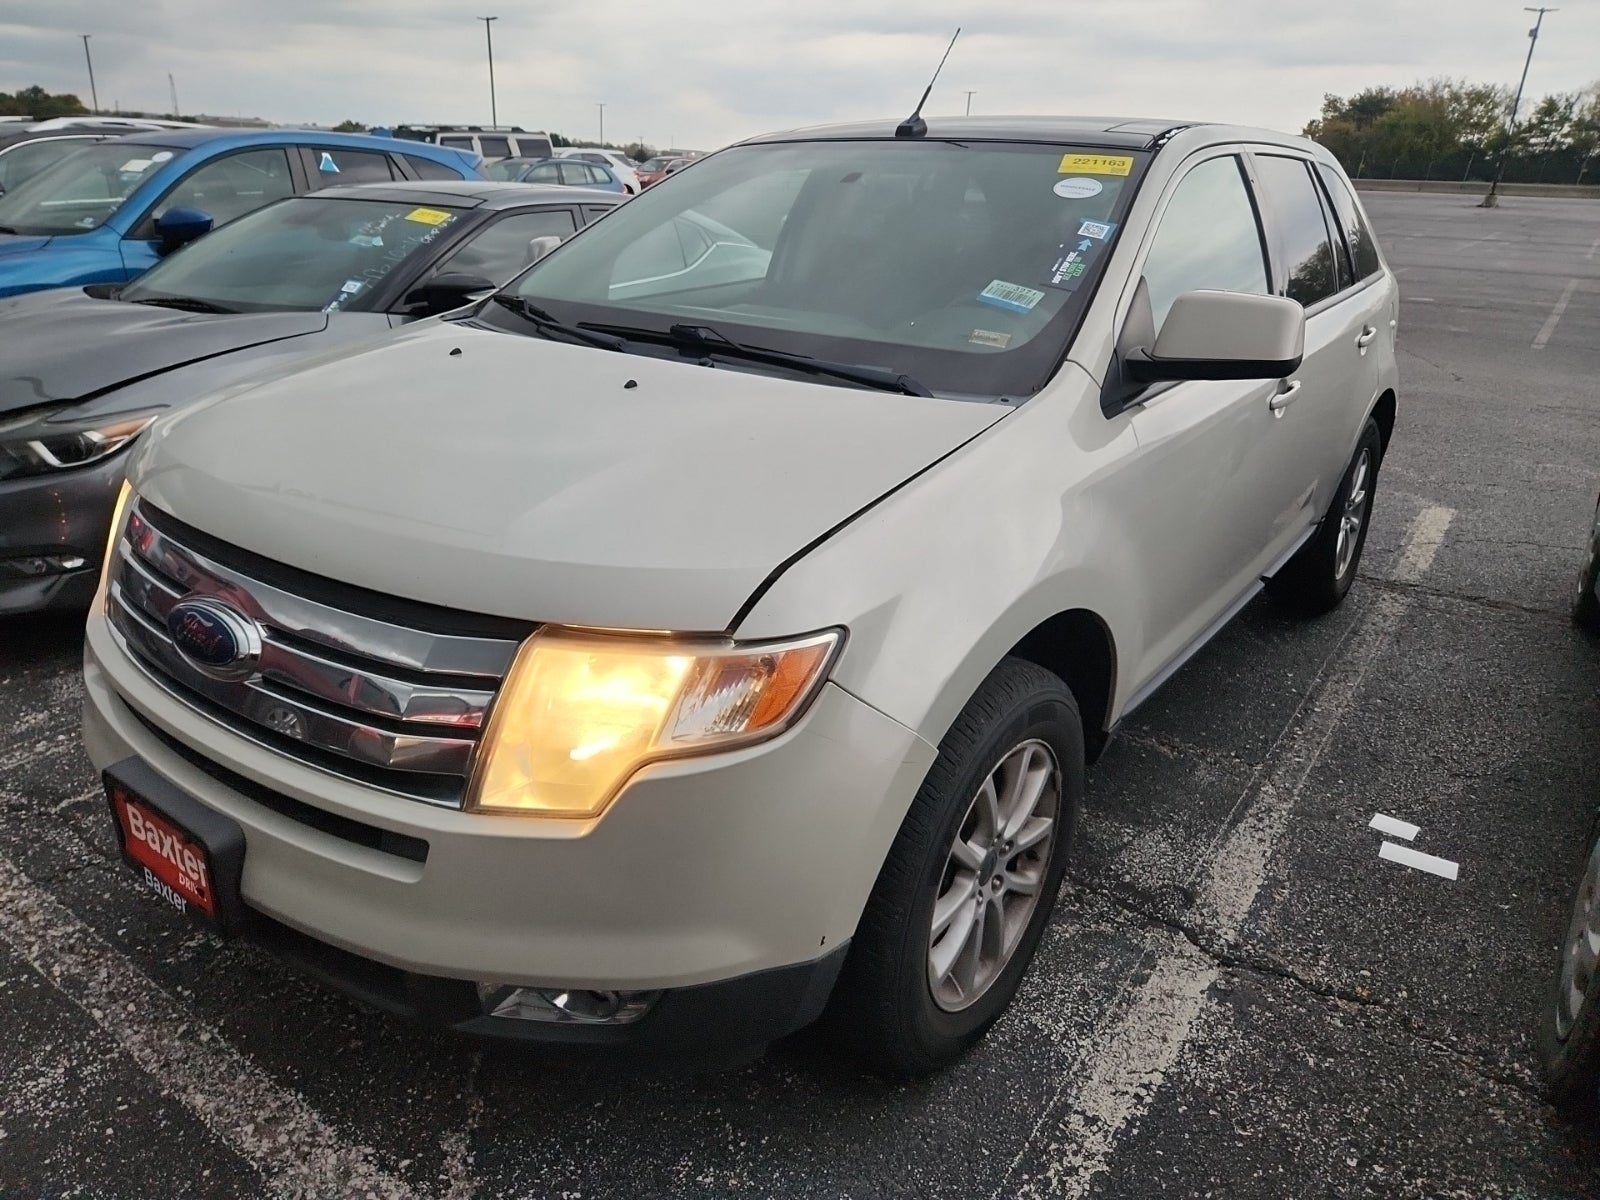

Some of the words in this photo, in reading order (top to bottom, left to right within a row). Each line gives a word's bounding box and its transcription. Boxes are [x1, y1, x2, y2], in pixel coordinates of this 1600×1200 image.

[1073, 157, 1126, 167] 221163
[126, 802, 206, 888] Baxter
[144, 866, 187, 913] Baxter
